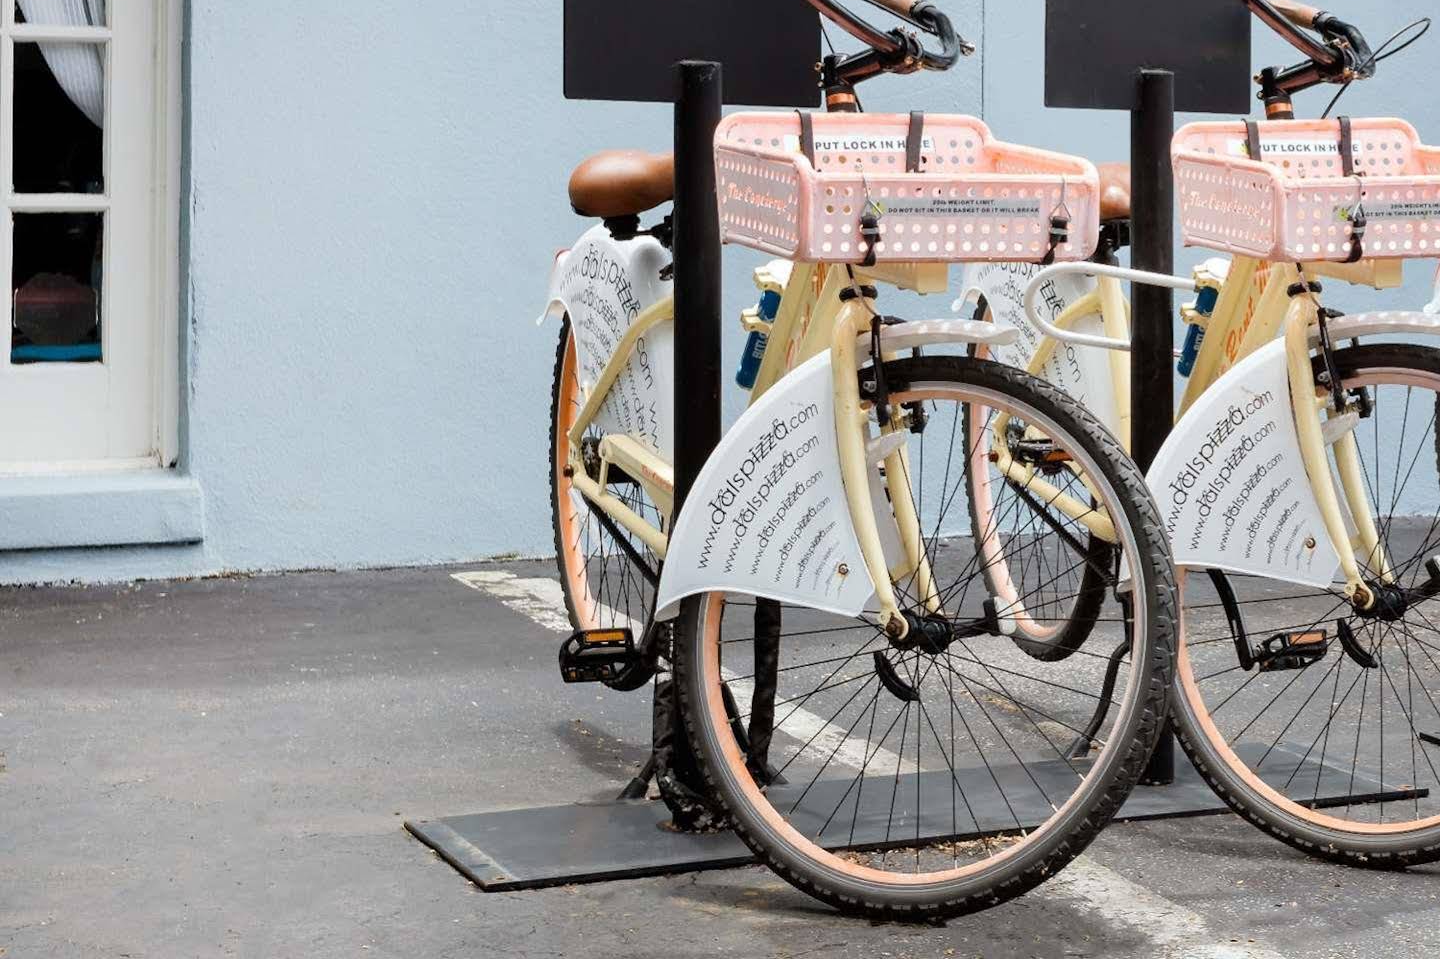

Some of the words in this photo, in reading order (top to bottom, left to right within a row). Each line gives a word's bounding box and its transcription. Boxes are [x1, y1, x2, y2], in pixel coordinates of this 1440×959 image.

[815, 141, 839, 150] PUT
[843, 140, 877, 150] LOCK
[880, 140, 893, 149] IN
[897, 140, 930, 149] HE
[1259, 144, 1277, 152] UT
[1280, 144, 1311, 152] LOCK
[698, 403, 819, 569] www.dalspizza.com
[724, 435, 819, 573] www.dalspizza.com
[750, 470, 824, 575] www.dalspizza.com
[1190, 421, 1277, 549] www.dalspizza.com
